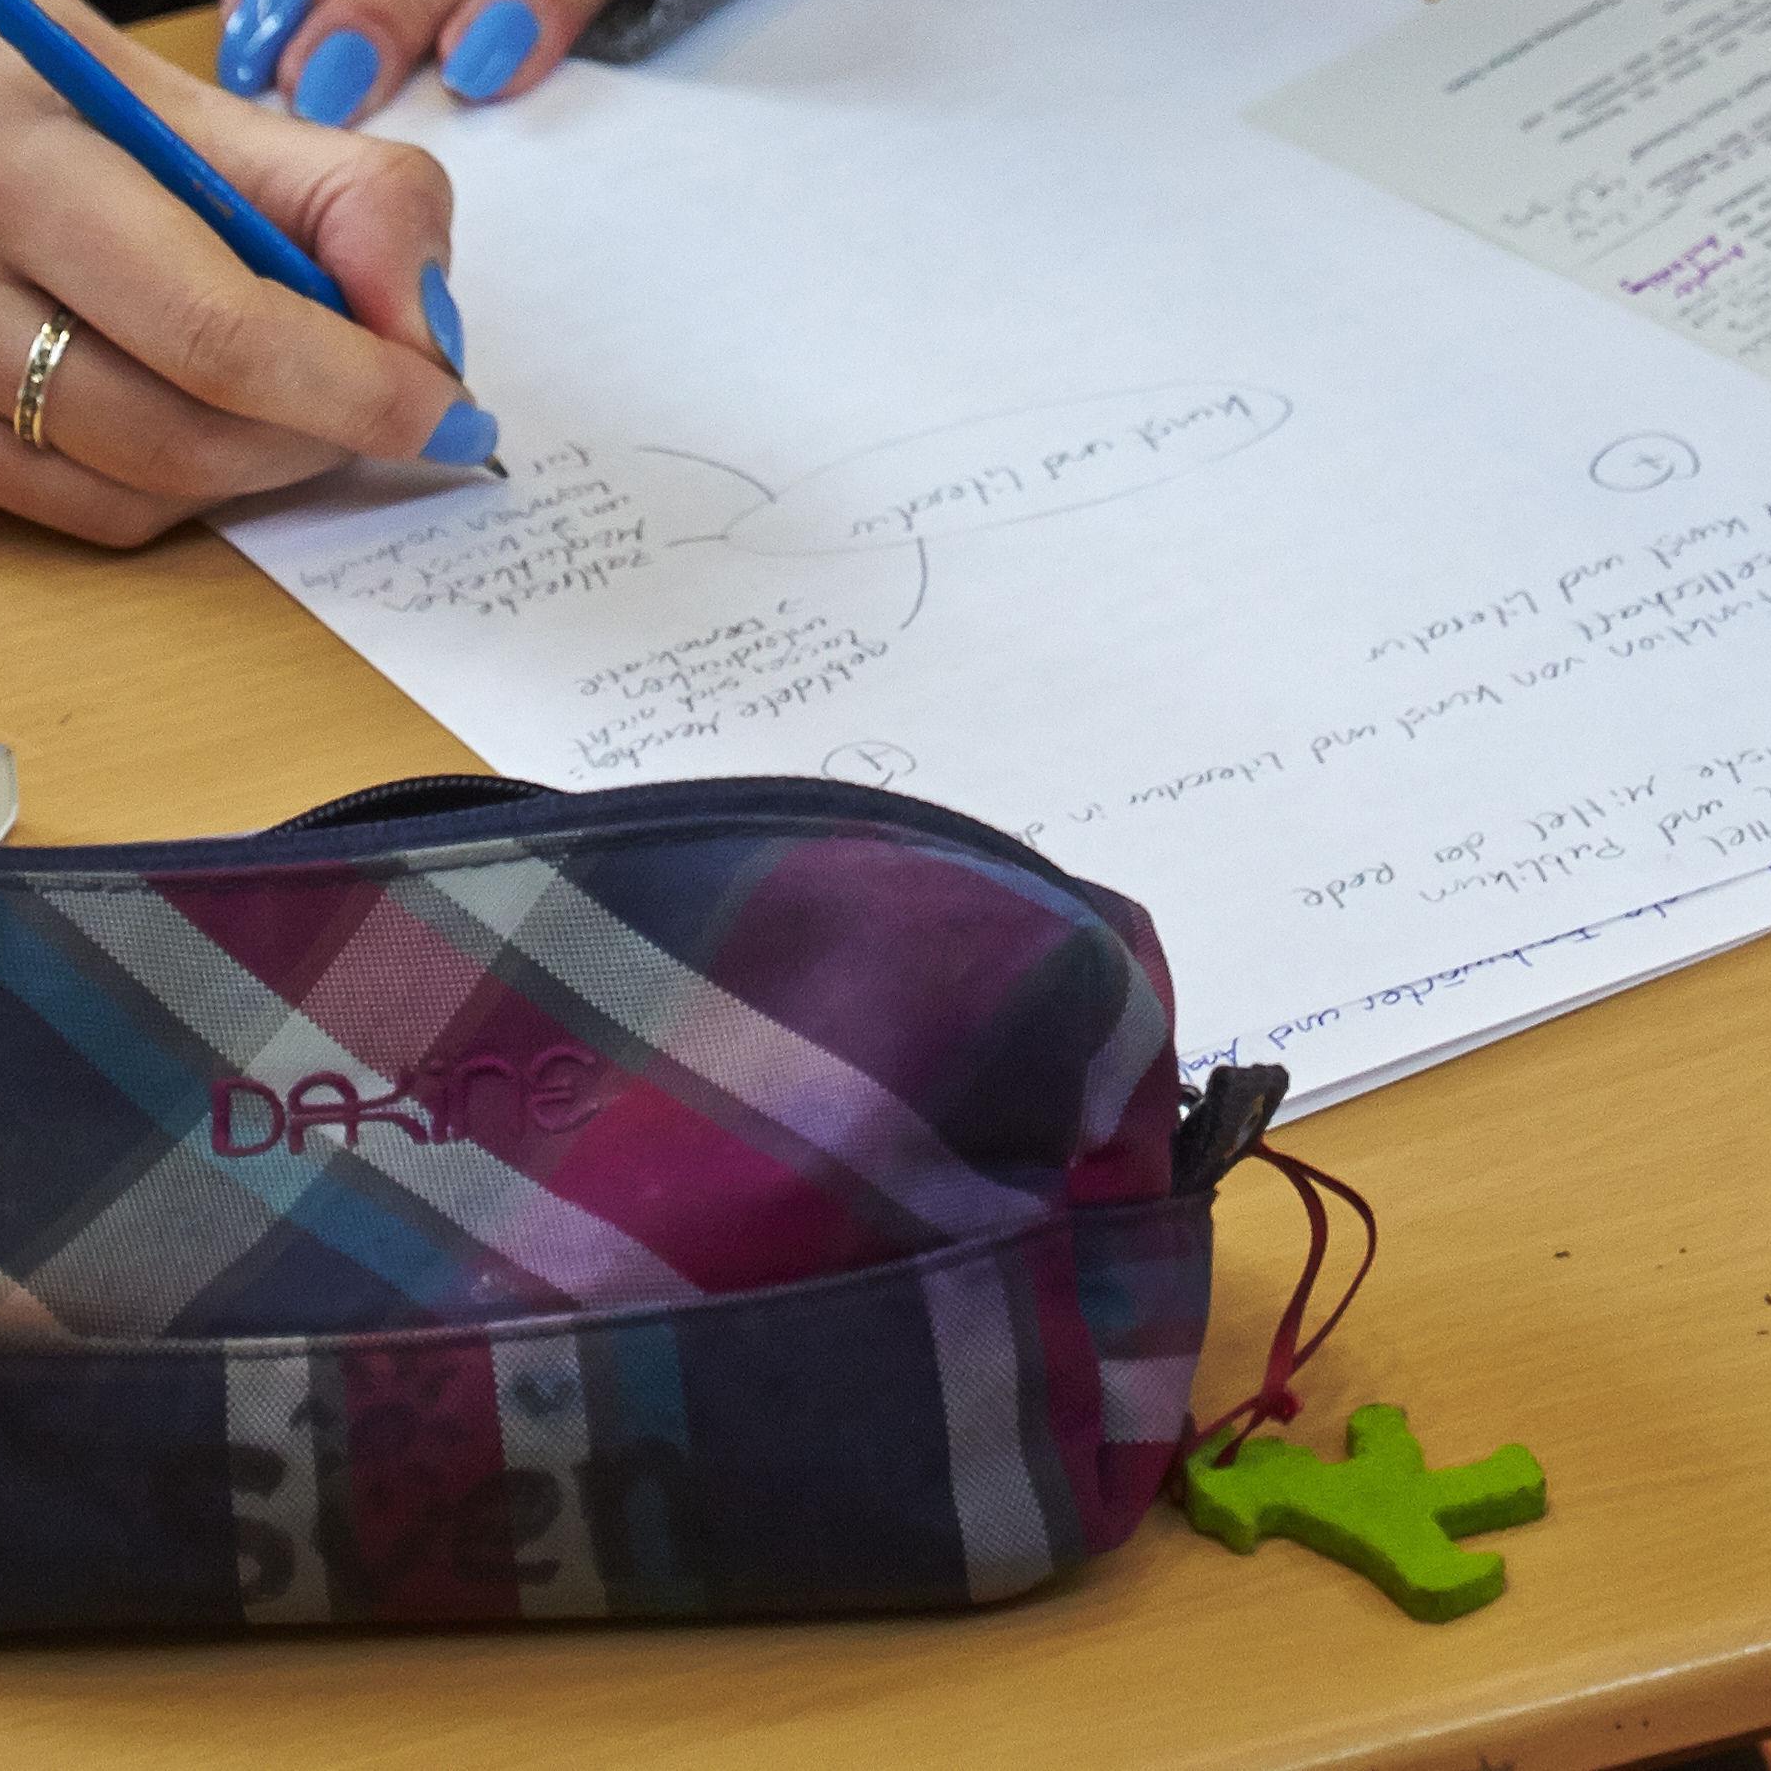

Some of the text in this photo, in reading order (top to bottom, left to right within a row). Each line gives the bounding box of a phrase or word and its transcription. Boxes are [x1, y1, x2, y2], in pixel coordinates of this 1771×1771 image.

[1041, 440, 1113, 480] und
[1555, 553, 1625, 605] und
[1362, 589, 1540, 665] Literatur
[1508, 656, 1584, 689] von
[1395, 684, 1503, 741] Kunst
[1309, 722, 1377, 764] und
[1127, 751, 1283, 806] Literatur
[1067, 802, 1105, 825] in
[1657, 800, 1724, 846] und
[1292, 862, 1394, 911] Rede
[1417, 836, 1625, 905] Publikum
[1266, 1008, 1340, 1051] und
